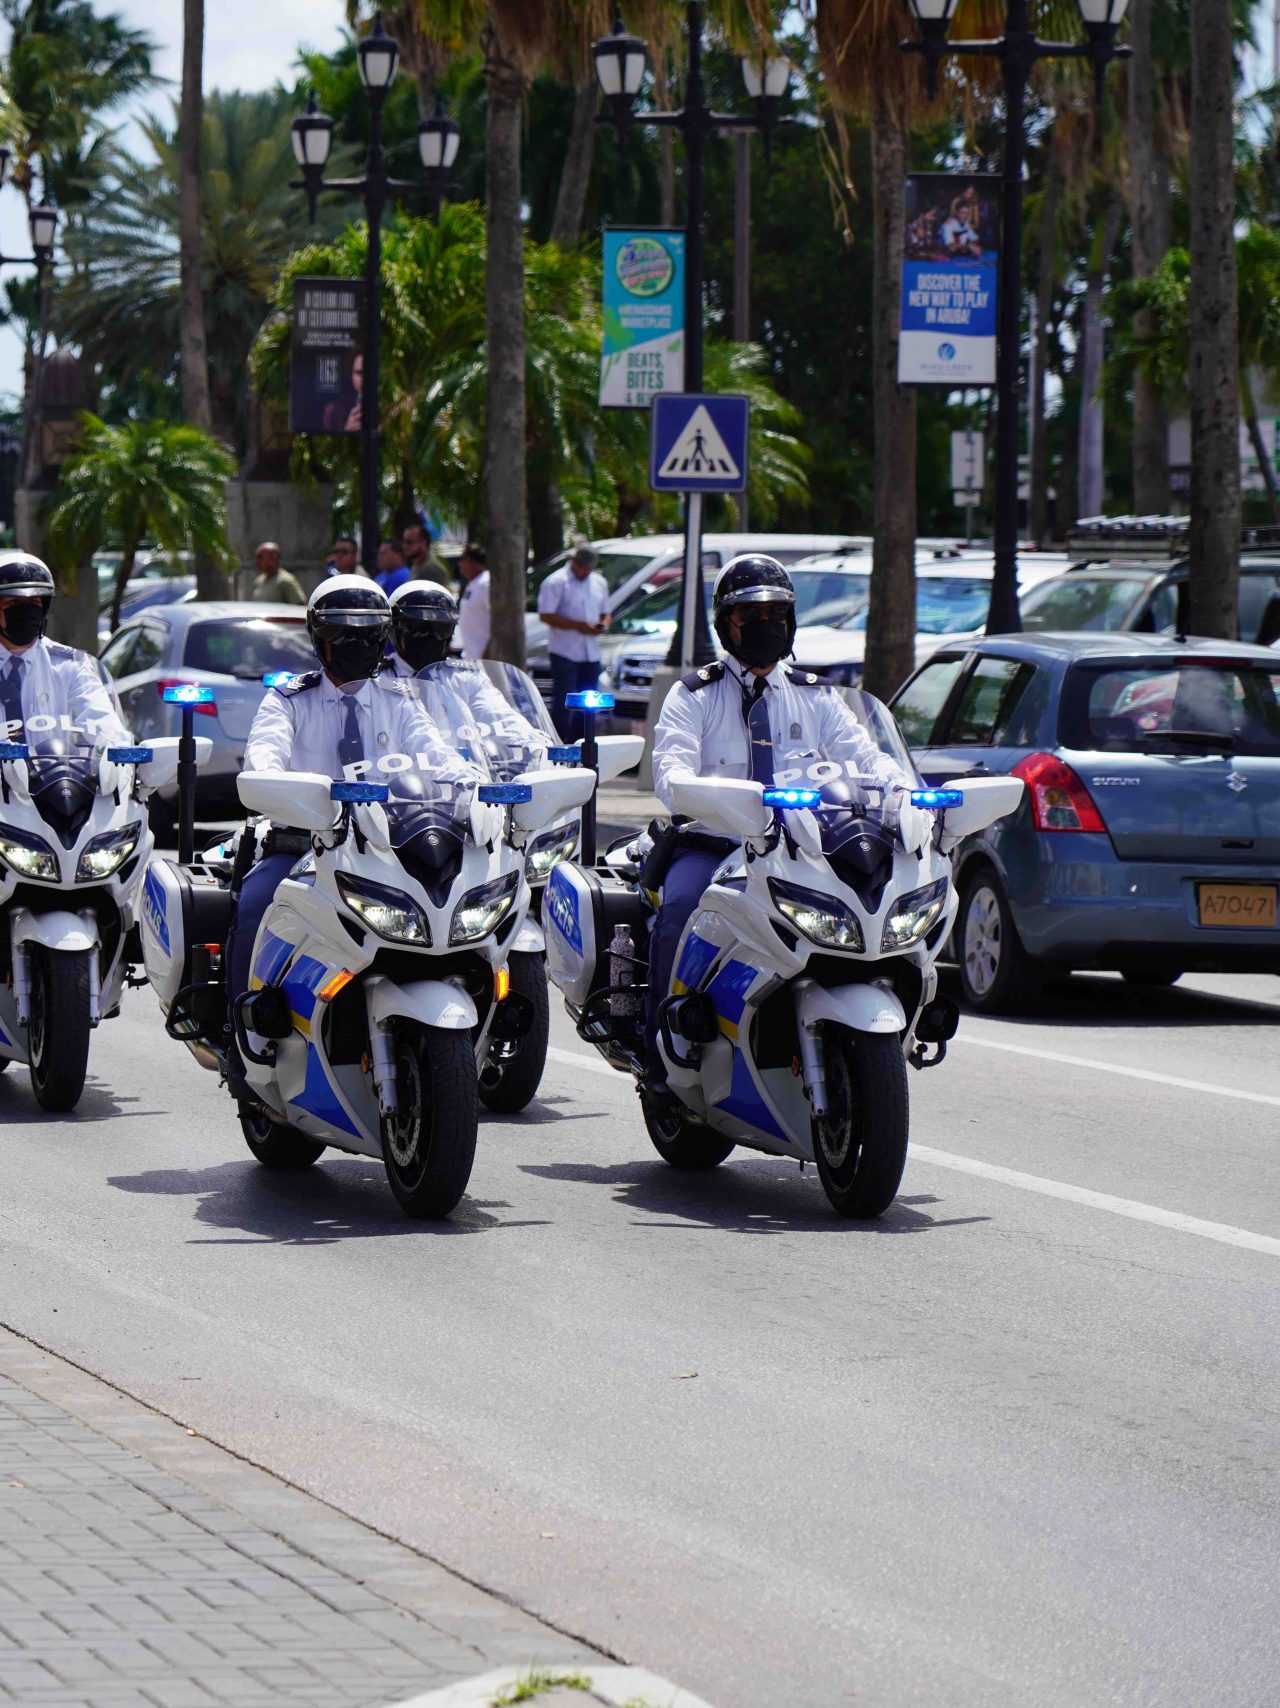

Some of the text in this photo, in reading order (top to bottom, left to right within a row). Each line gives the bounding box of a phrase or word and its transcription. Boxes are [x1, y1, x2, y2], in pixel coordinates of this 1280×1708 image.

[917, 273, 981, 291] DISCOVER THE
[909, 290, 989, 308] NEW WAY TO PLAY
[925, 308, 936, 323] IN
[627, 371, 663, 389] BITES
[1092, 777, 1141, 786] SUZUKI
